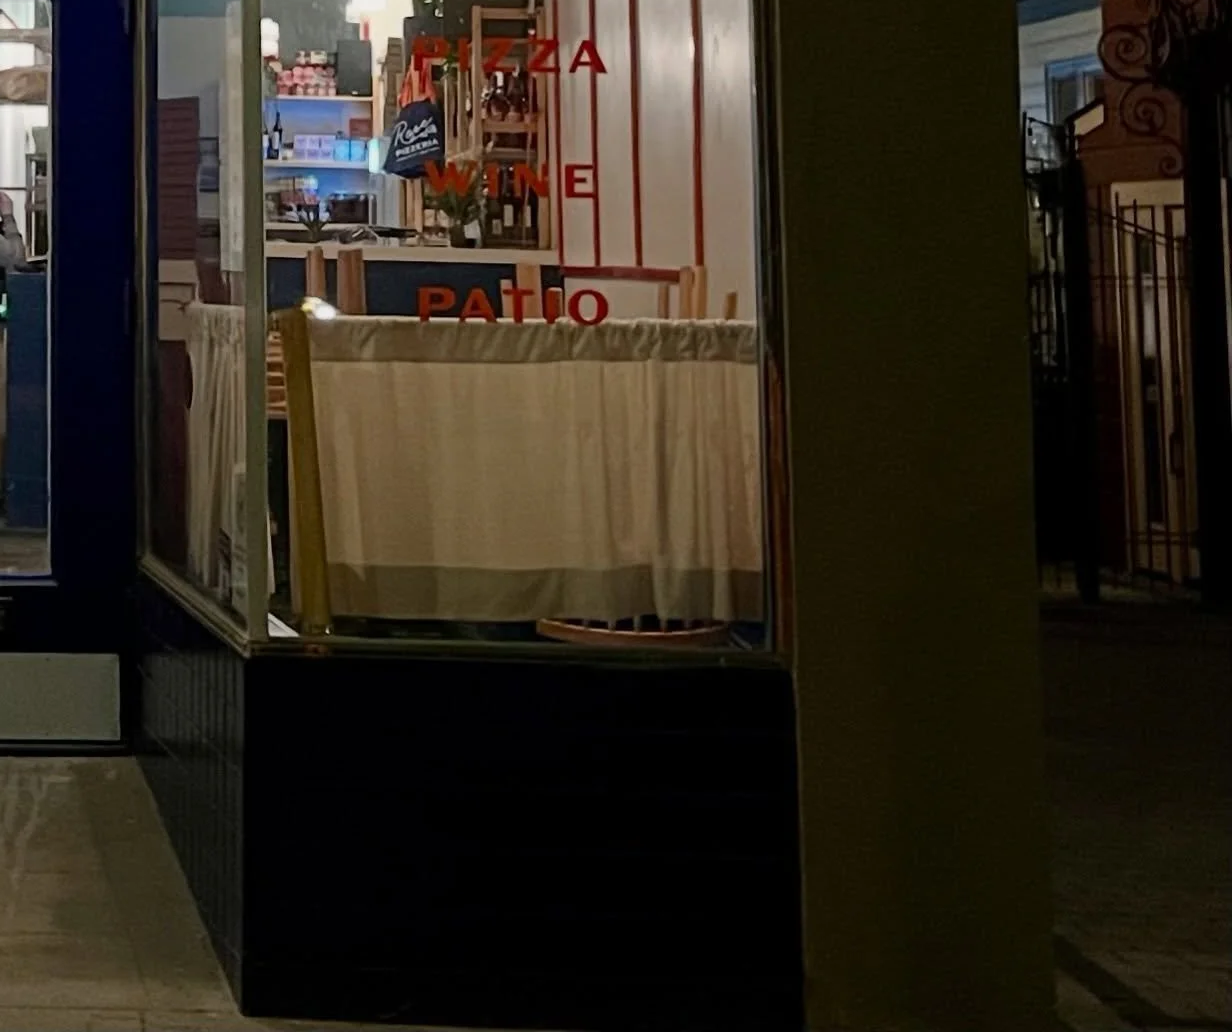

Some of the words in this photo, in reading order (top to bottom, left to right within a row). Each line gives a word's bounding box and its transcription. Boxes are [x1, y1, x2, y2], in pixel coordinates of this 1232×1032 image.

[411, 36, 608, 74] PIZZA
[425, 161, 597, 199] WINE
[418, 287, 609, 326] PATIO
